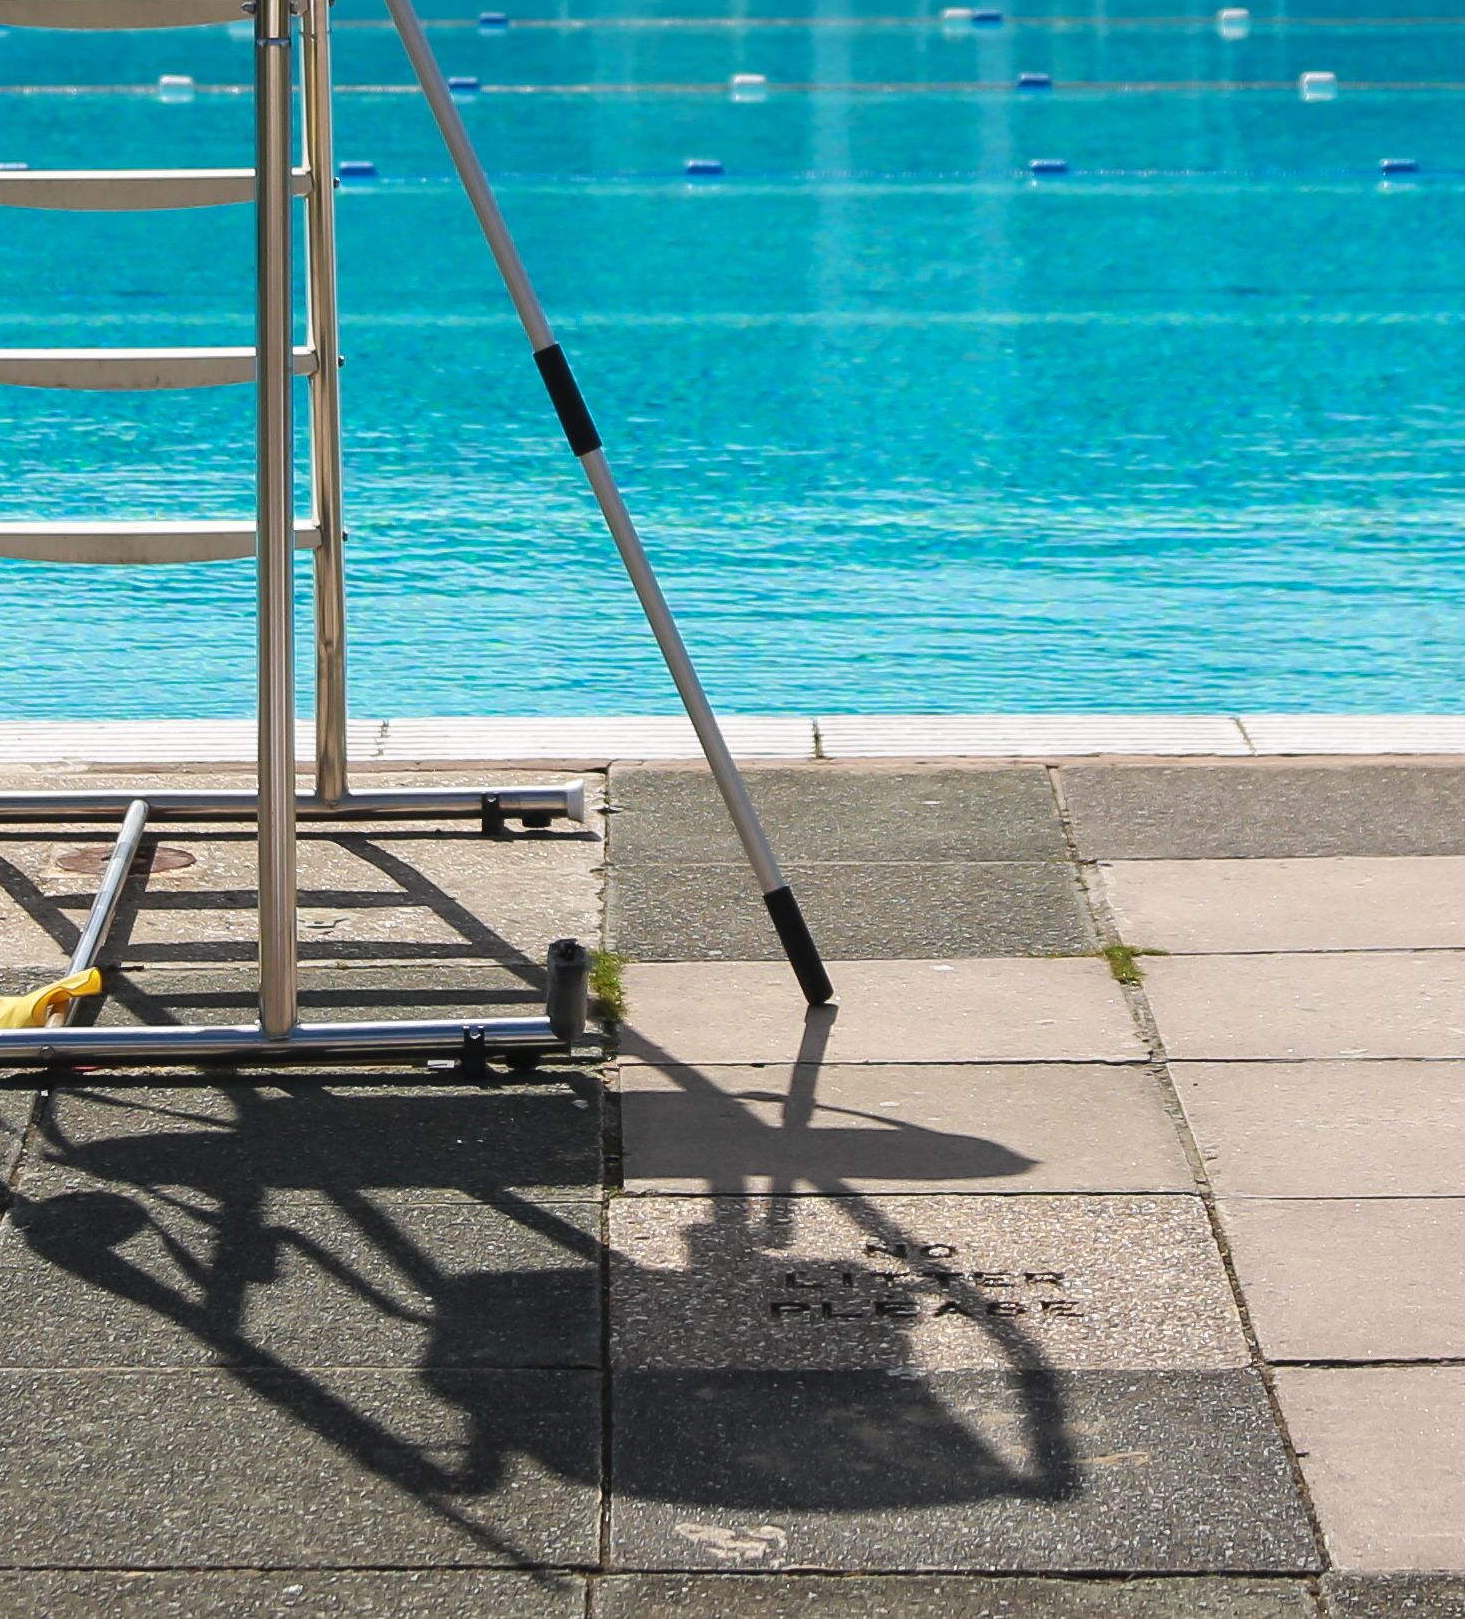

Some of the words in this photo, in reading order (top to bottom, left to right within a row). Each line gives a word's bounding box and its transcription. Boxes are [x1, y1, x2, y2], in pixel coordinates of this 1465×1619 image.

[865, 1242, 957, 1259] NO
[785, 1271, 1066, 1288] LITTER
[770, 1300, 1085, 1319] PLEASE
